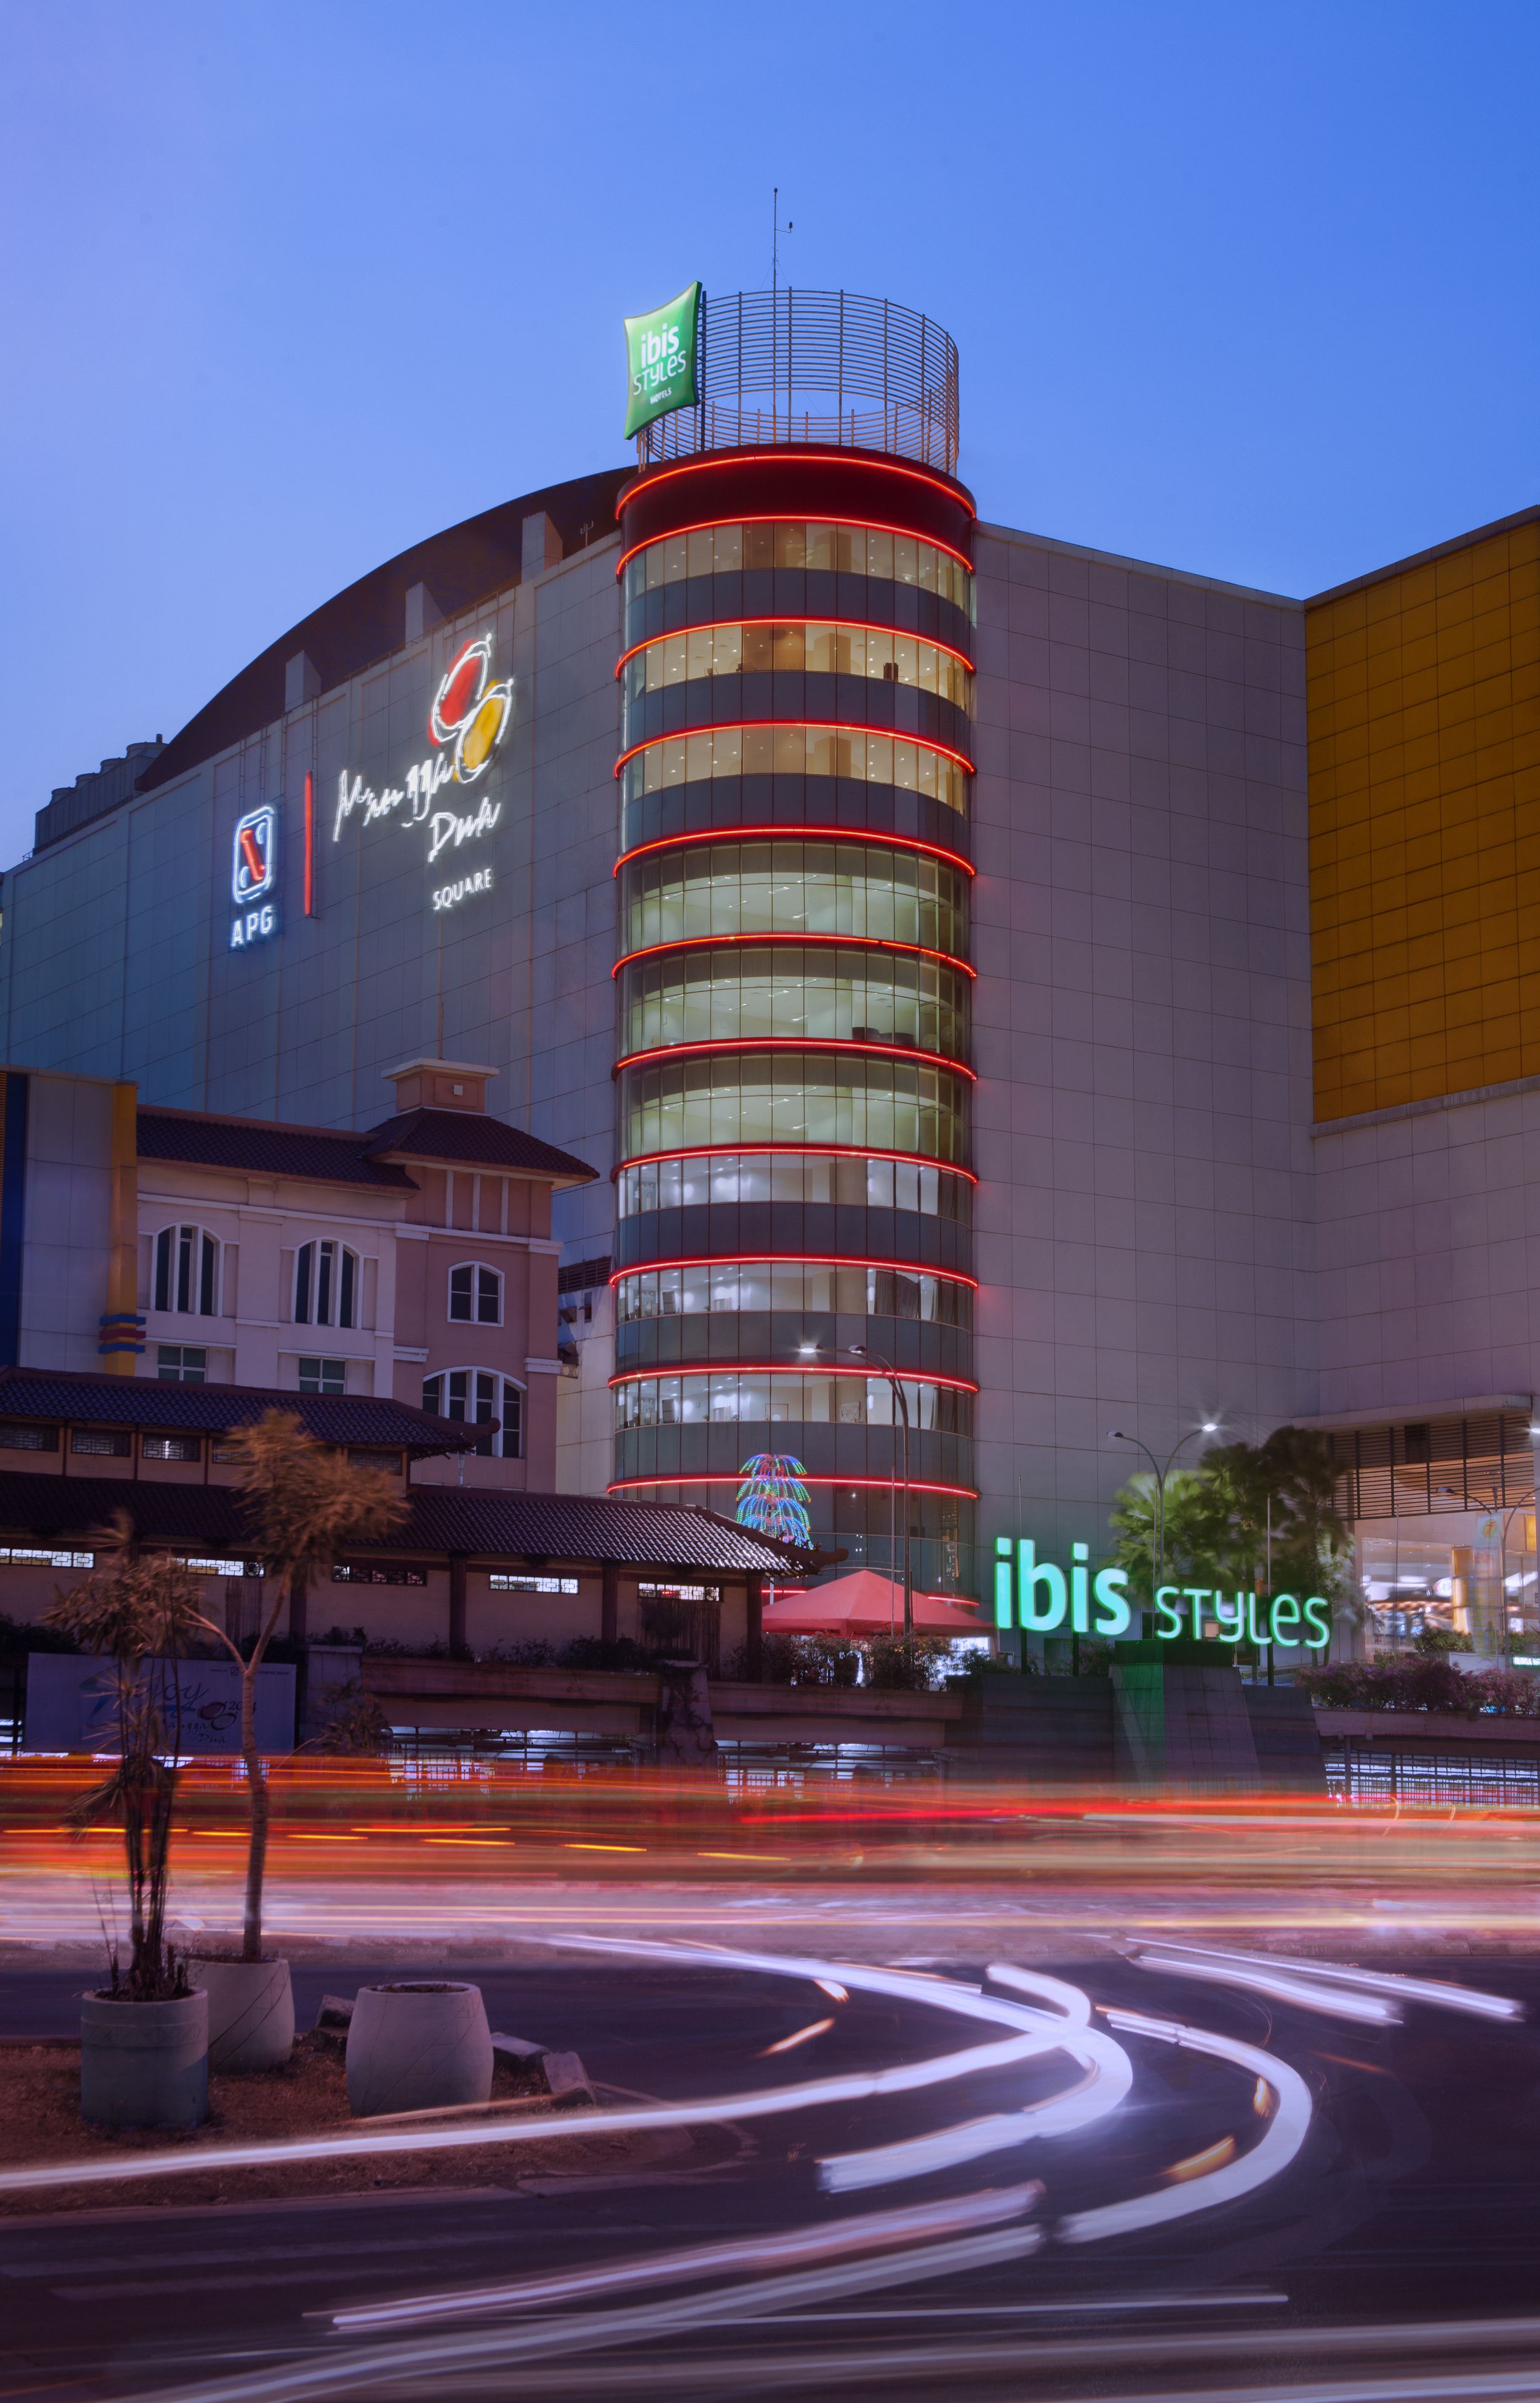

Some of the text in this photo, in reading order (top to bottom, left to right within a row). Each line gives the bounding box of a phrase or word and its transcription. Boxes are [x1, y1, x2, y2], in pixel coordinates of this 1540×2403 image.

[641, 322, 680, 369] ibis
[650, 387, 672, 404] HOTELS
[432, 867, 492, 911] SQUARE
[230, 906, 274, 947] APG
[994, 1537, 1131, 1636] ibis
[198, 1732, 228, 1743] Dua
